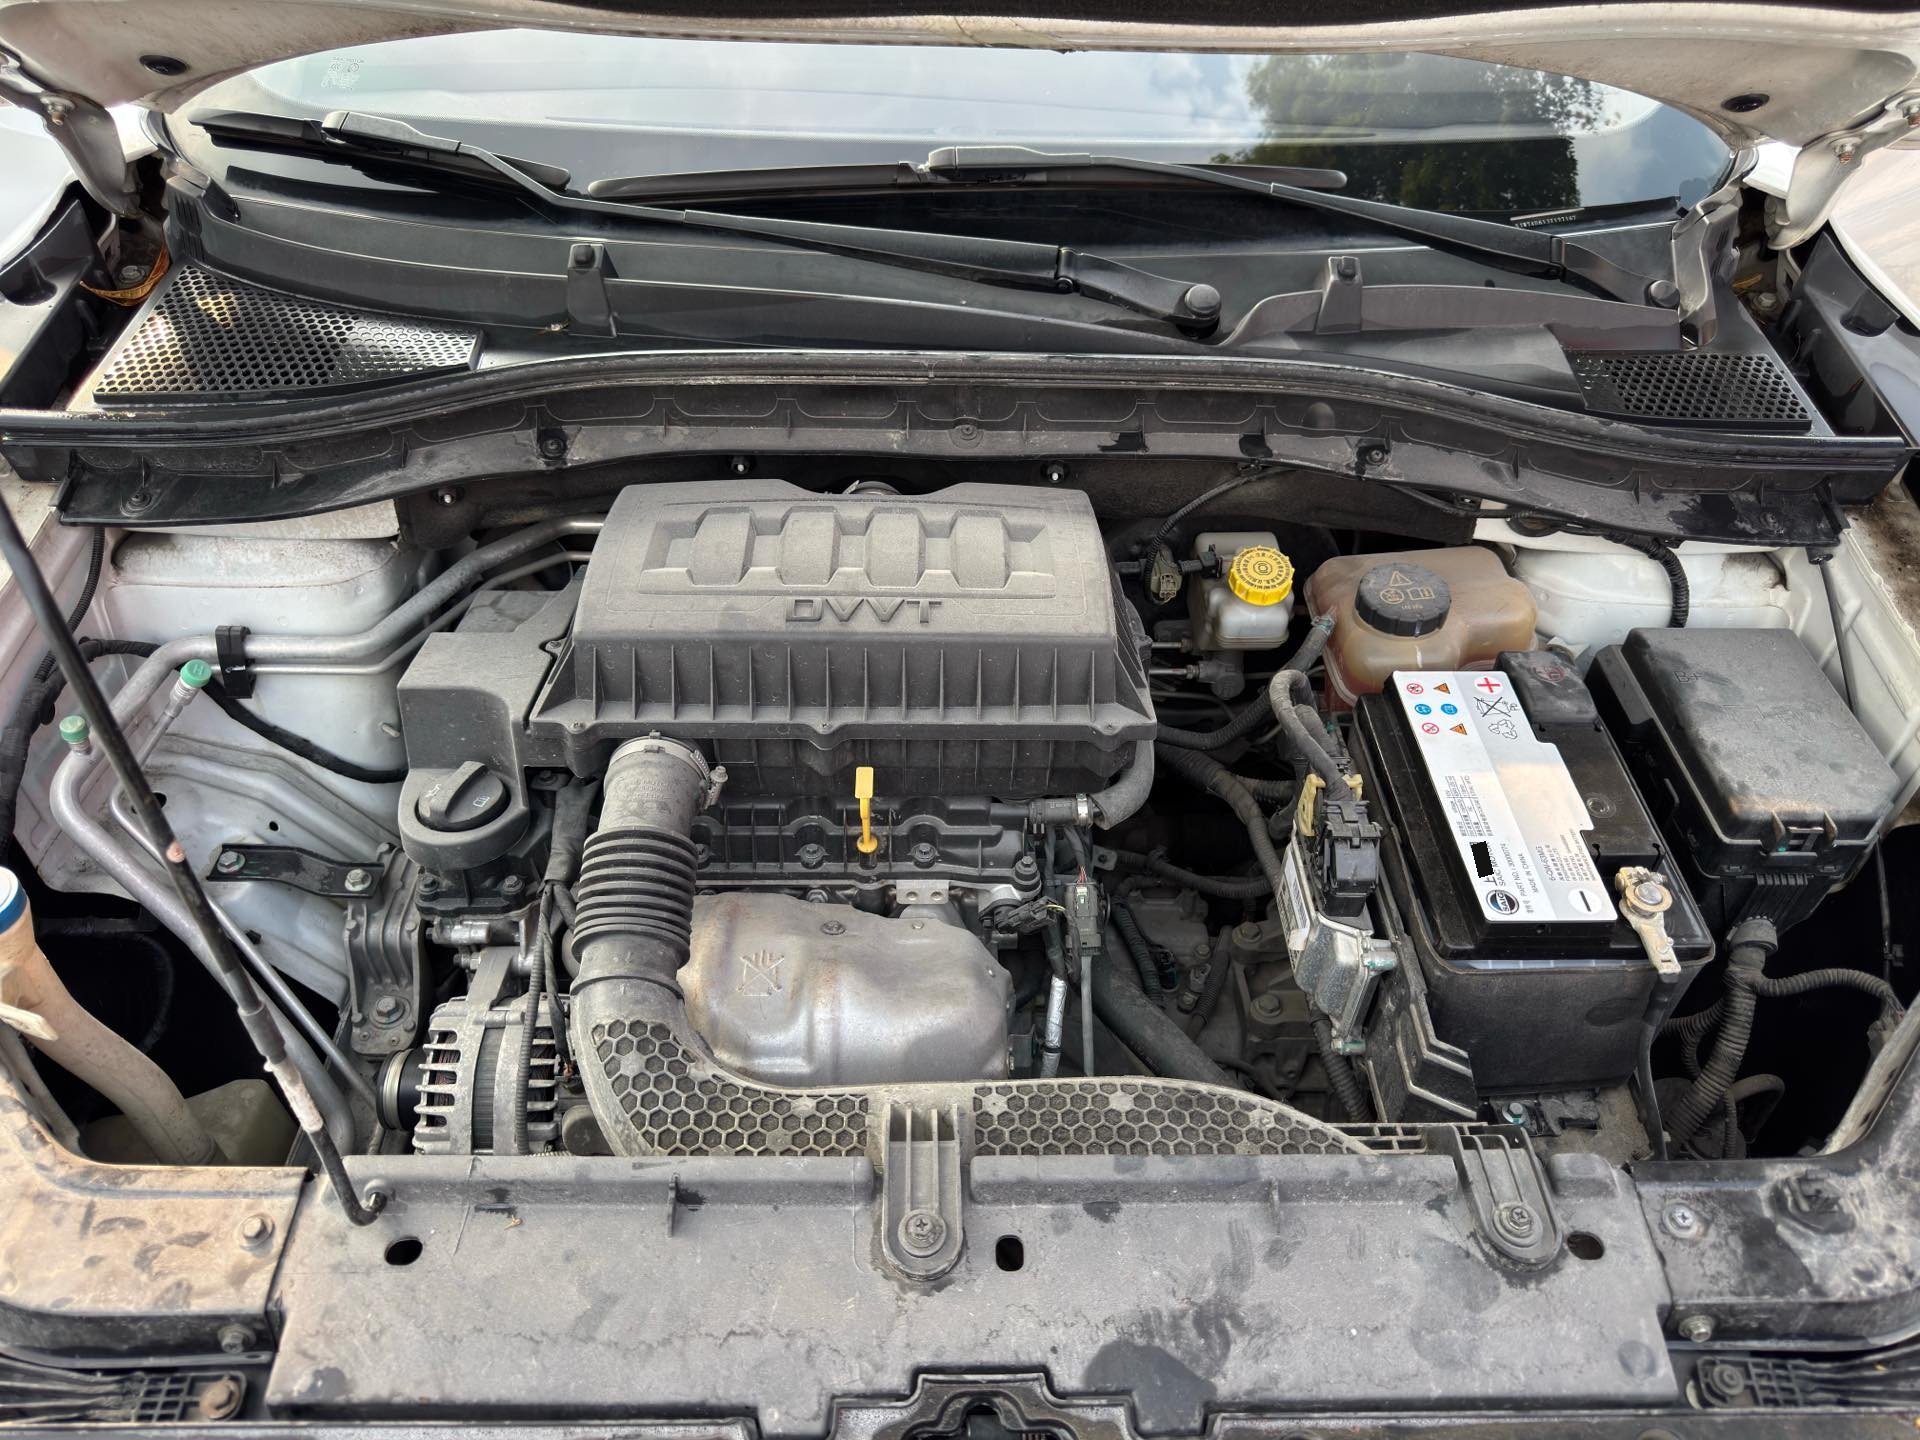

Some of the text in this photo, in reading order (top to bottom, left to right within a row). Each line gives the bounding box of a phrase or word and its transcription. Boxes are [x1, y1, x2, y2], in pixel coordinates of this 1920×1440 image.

[786, 599, 942, 624] DVVT
[1493, 868, 1506, 886] SAIC
[1496, 892, 1510, 911] SAIC
